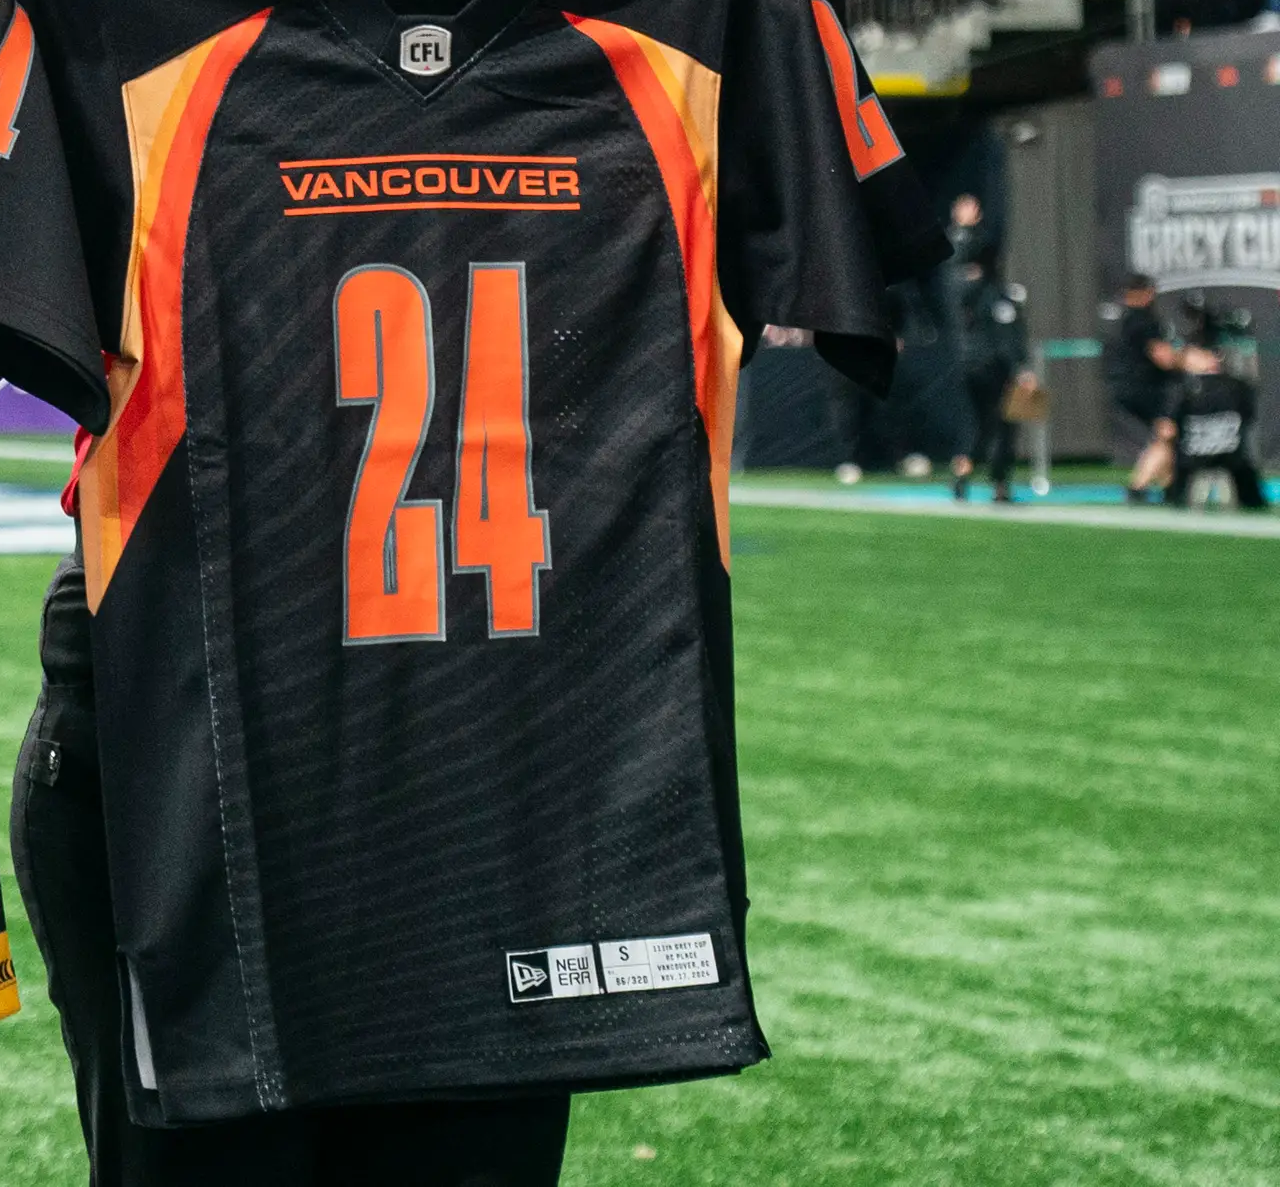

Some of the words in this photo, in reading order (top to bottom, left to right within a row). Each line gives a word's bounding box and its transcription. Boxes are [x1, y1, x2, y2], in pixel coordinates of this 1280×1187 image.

[409, 41, 444, 64] CFL
[281, 167, 580, 202] VANCOUVER
[333, 261, 551, 646] 24
[618, 945, 630, 961] S
[555, 956, 589, 972] NEW
[558, 970, 591, 986] ERA
